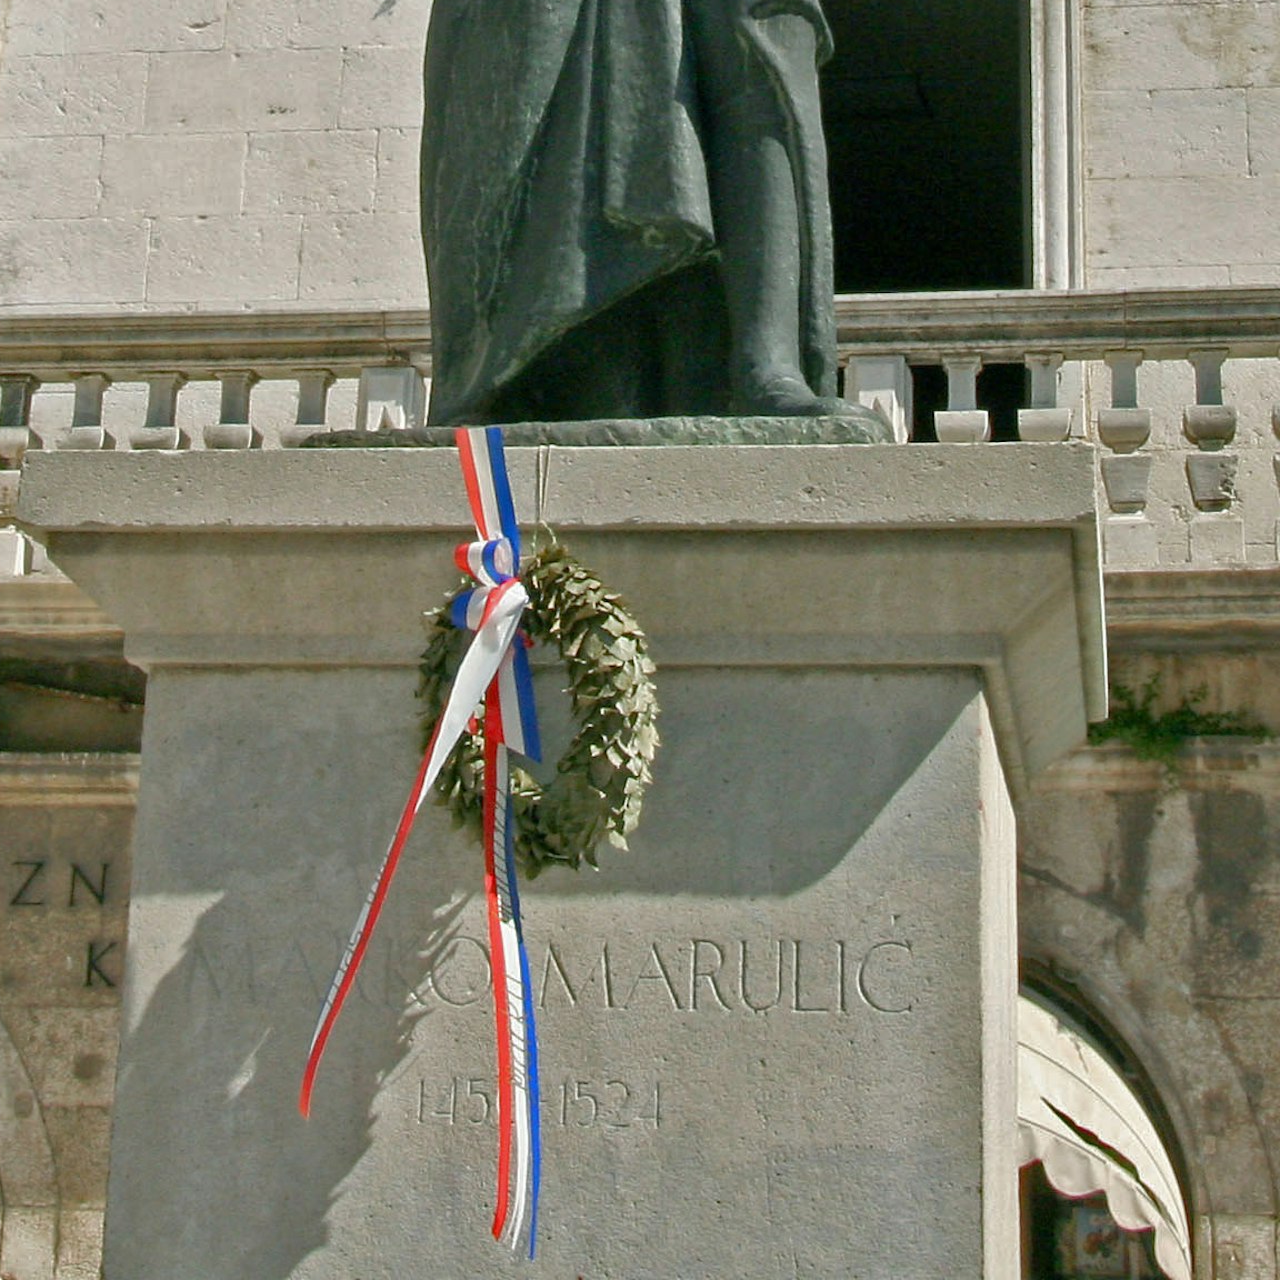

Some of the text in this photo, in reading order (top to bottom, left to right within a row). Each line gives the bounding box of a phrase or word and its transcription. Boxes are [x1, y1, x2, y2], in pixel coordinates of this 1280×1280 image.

[10, 859, 110, 907] ZN
[83, 941, 118, 988] K
[536, 914, 915, 1016] MARULIĆ
